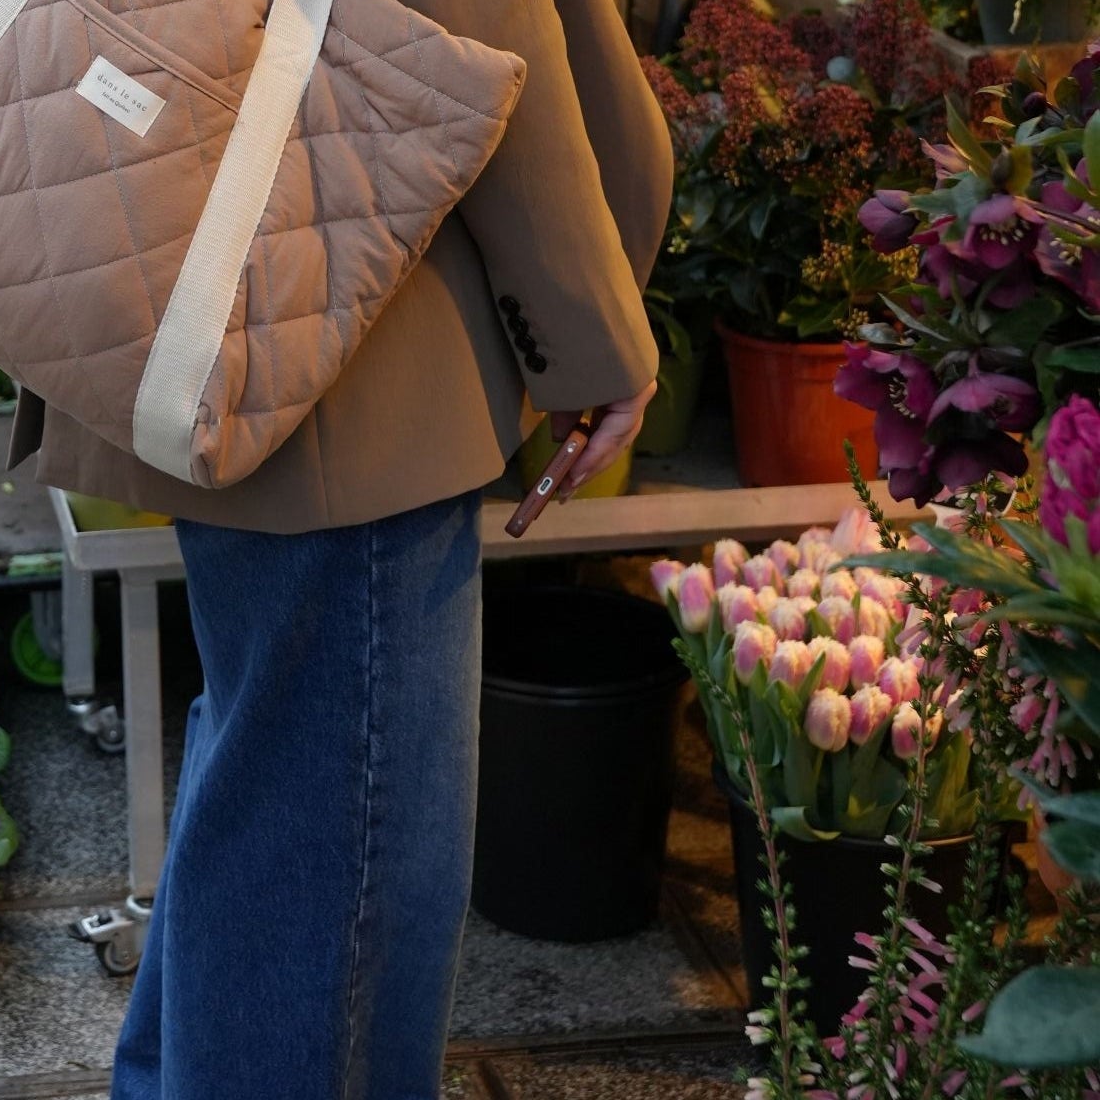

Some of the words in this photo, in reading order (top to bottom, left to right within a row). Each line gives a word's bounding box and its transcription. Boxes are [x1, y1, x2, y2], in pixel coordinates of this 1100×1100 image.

[97, 74, 117, 91] dans
[120, 89, 130, 100] le
[131, 99, 147, 112] sac
